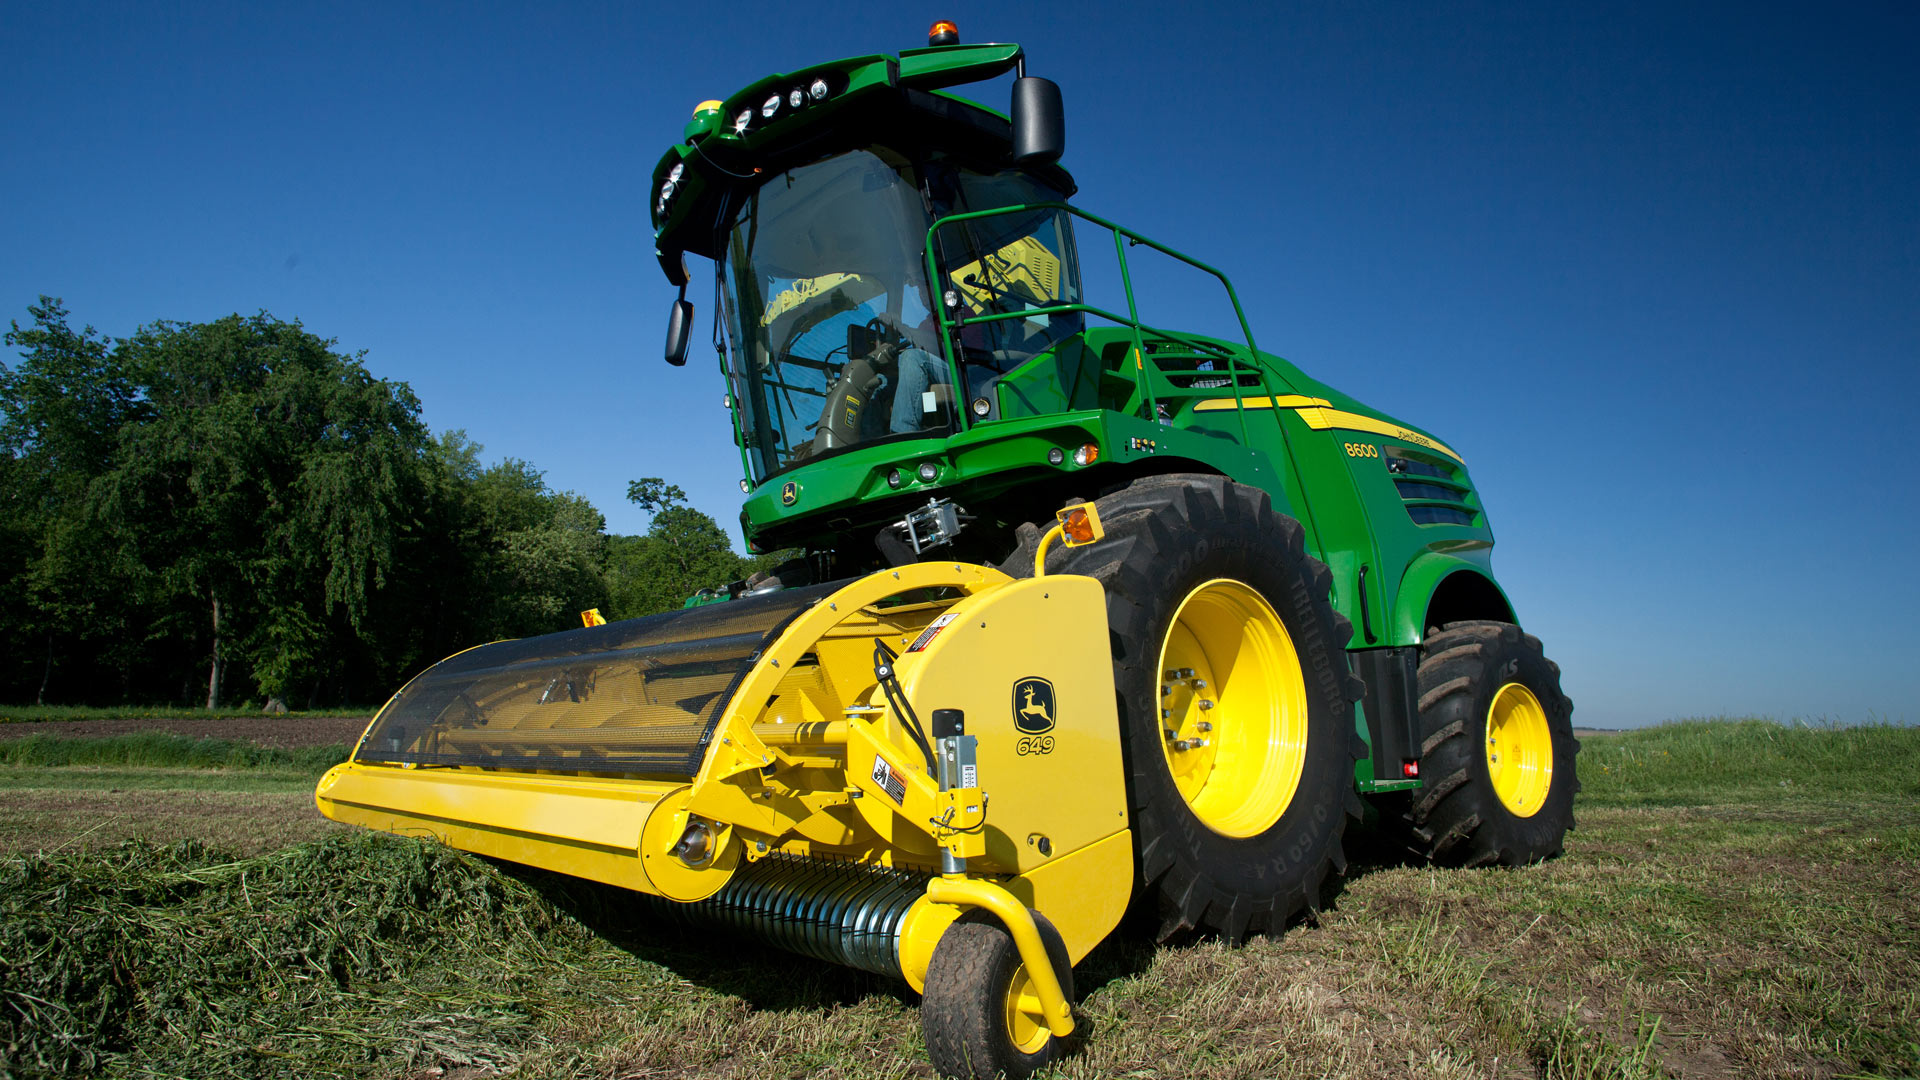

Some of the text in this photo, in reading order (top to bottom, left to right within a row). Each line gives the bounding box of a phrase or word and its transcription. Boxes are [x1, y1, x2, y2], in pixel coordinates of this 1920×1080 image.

[1344, 442, 1378, 458] 8600
[1290, 572, 1345, 716] TRELLEBORG
[1016, 735, 1055, 756] 649
